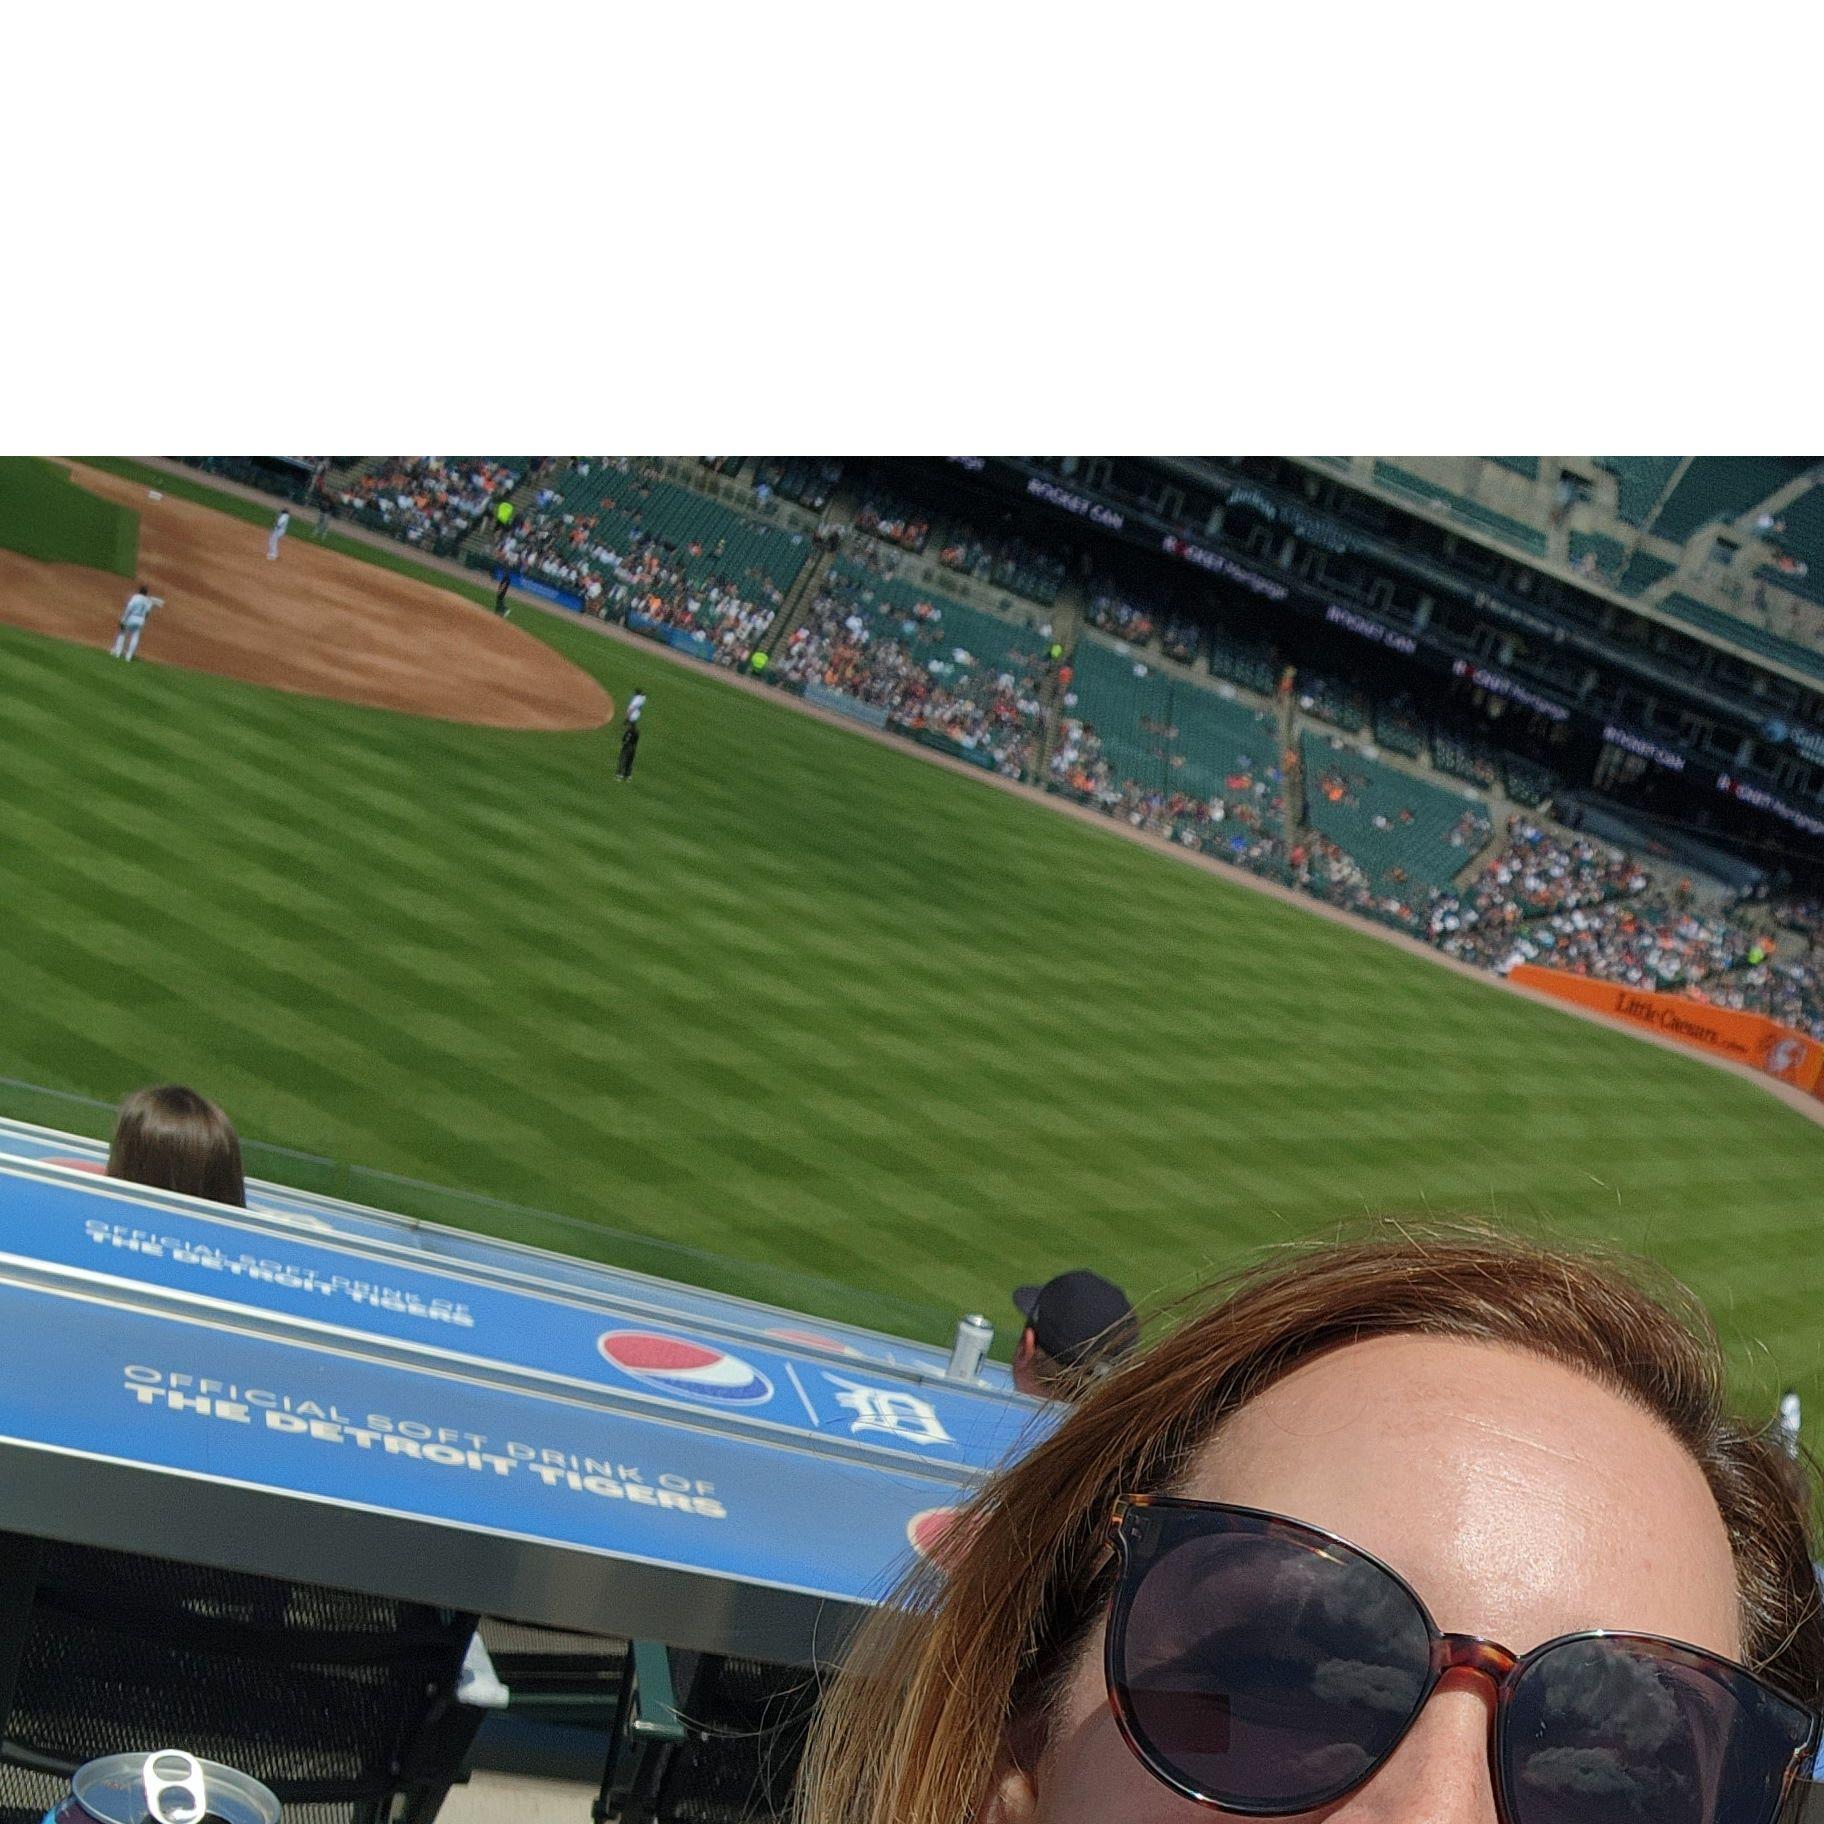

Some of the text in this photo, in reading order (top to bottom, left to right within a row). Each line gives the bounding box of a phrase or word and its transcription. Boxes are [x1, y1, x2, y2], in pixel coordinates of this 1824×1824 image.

[86, 1219, 225, 1260] OFFICIAL
[240, 1253, 319, 1281] SOFT
[86, 1229, 475, 1328] THE DETROIT TIGERS
[124, 1364, 716, 1496] OFFICIAL SOFT DRINK OF
[124, 1381, 728, 1520] THE DETROIT TIGERS
